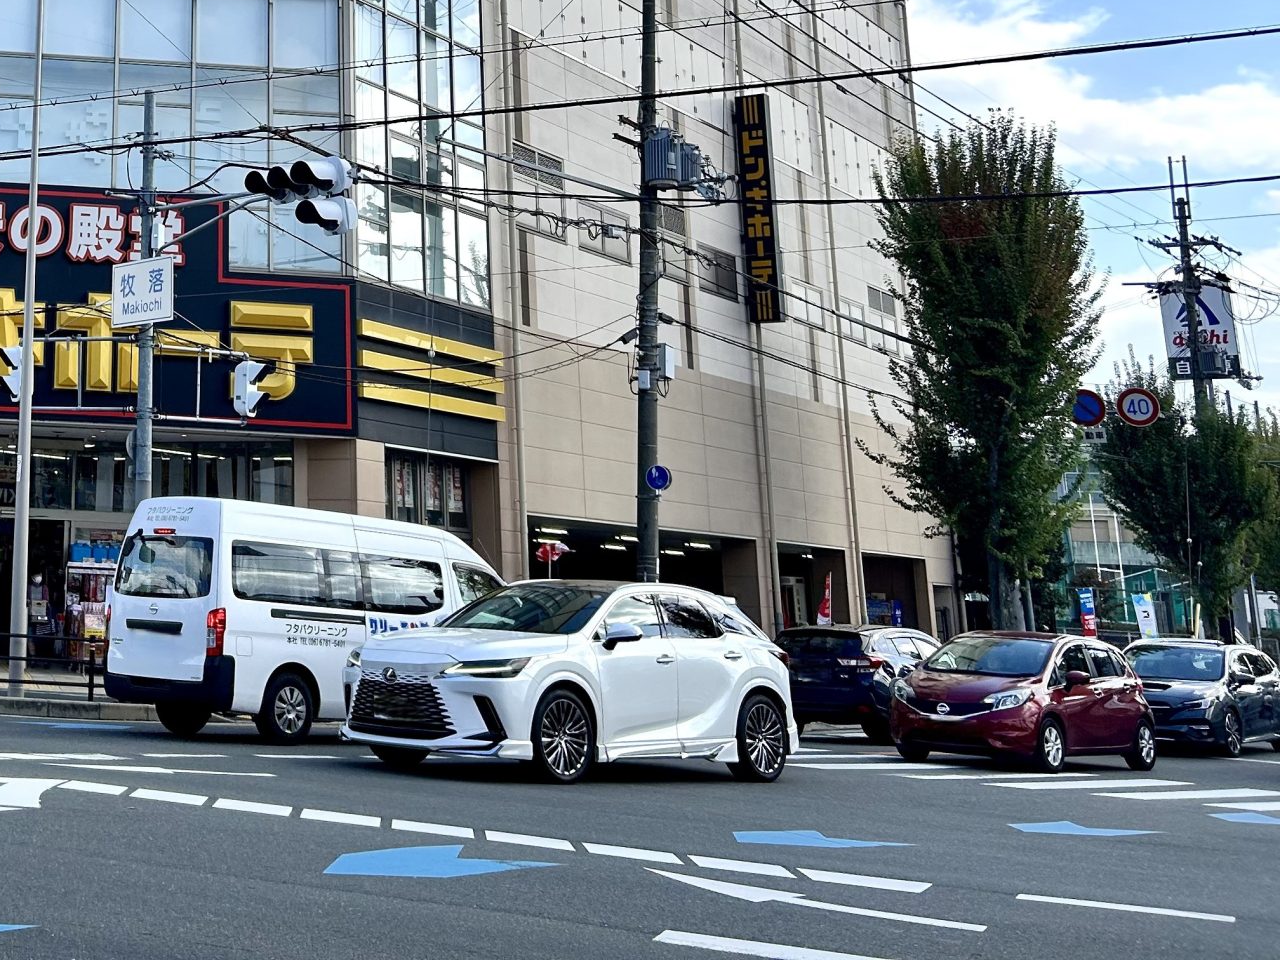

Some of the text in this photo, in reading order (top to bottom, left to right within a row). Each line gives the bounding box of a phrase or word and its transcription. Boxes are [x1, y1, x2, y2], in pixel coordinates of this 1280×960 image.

[120, 268, 163, 298] 牧落
[122, 297, 162, 315] Makiochi
[1173, 329, 1229, 348] ahi
[1127, 399, 1150, 416] 40
[285, 623, 348, 638] フタバクリーニング
